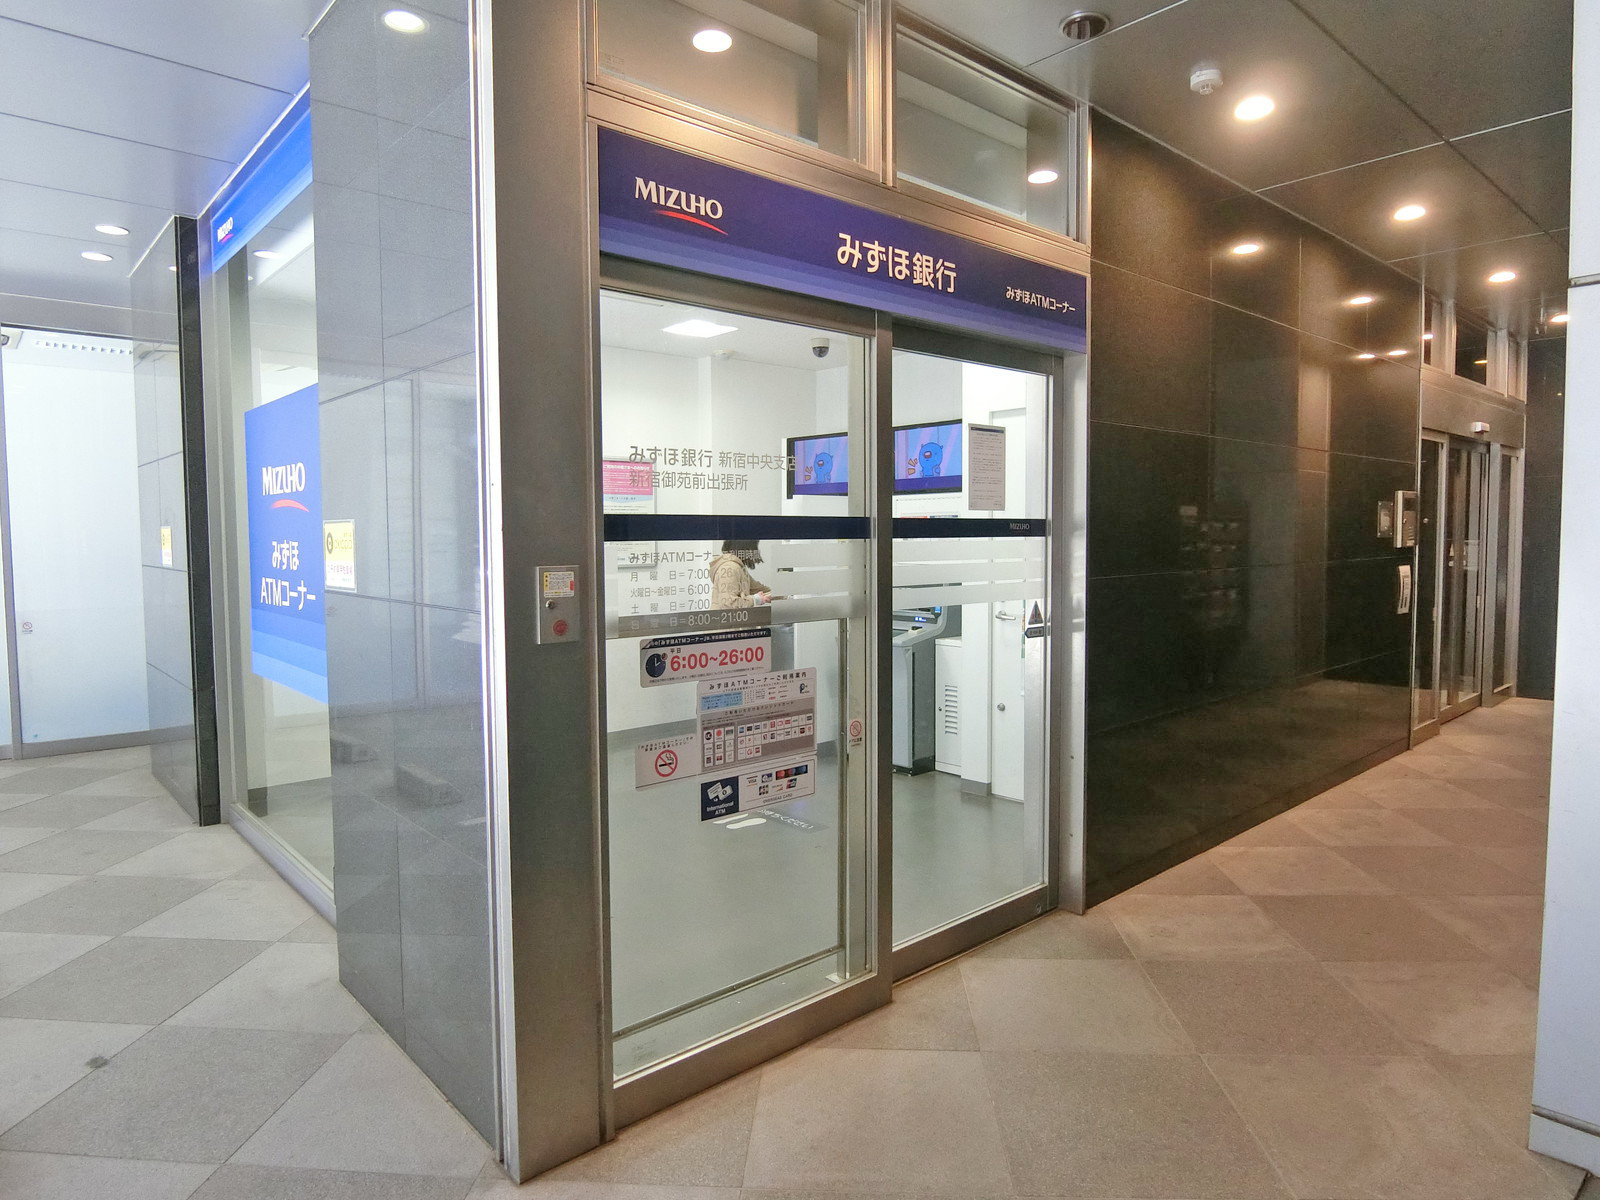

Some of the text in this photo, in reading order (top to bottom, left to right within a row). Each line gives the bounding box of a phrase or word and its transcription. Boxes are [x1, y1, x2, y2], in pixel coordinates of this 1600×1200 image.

[635, 176, 723, 219] MIZUHO
[837, 232, 957, 293] みずほ銀行
[1006, 286, 1076, 313] みずほATMコーナー
[628, 446, 796, 472] みずほ銀行 新宿中央支店
[262, 462, 306, 496] MIZUHO
[629, 469, 748, 491] 新宿御苑前出張所
[1009, 522, 1030, 530] MIZUHO
[271, 540, 300, 571] みずほ
[260, 577, 316, 611] ATMコーナー
[706, 801, 734, 812] International
